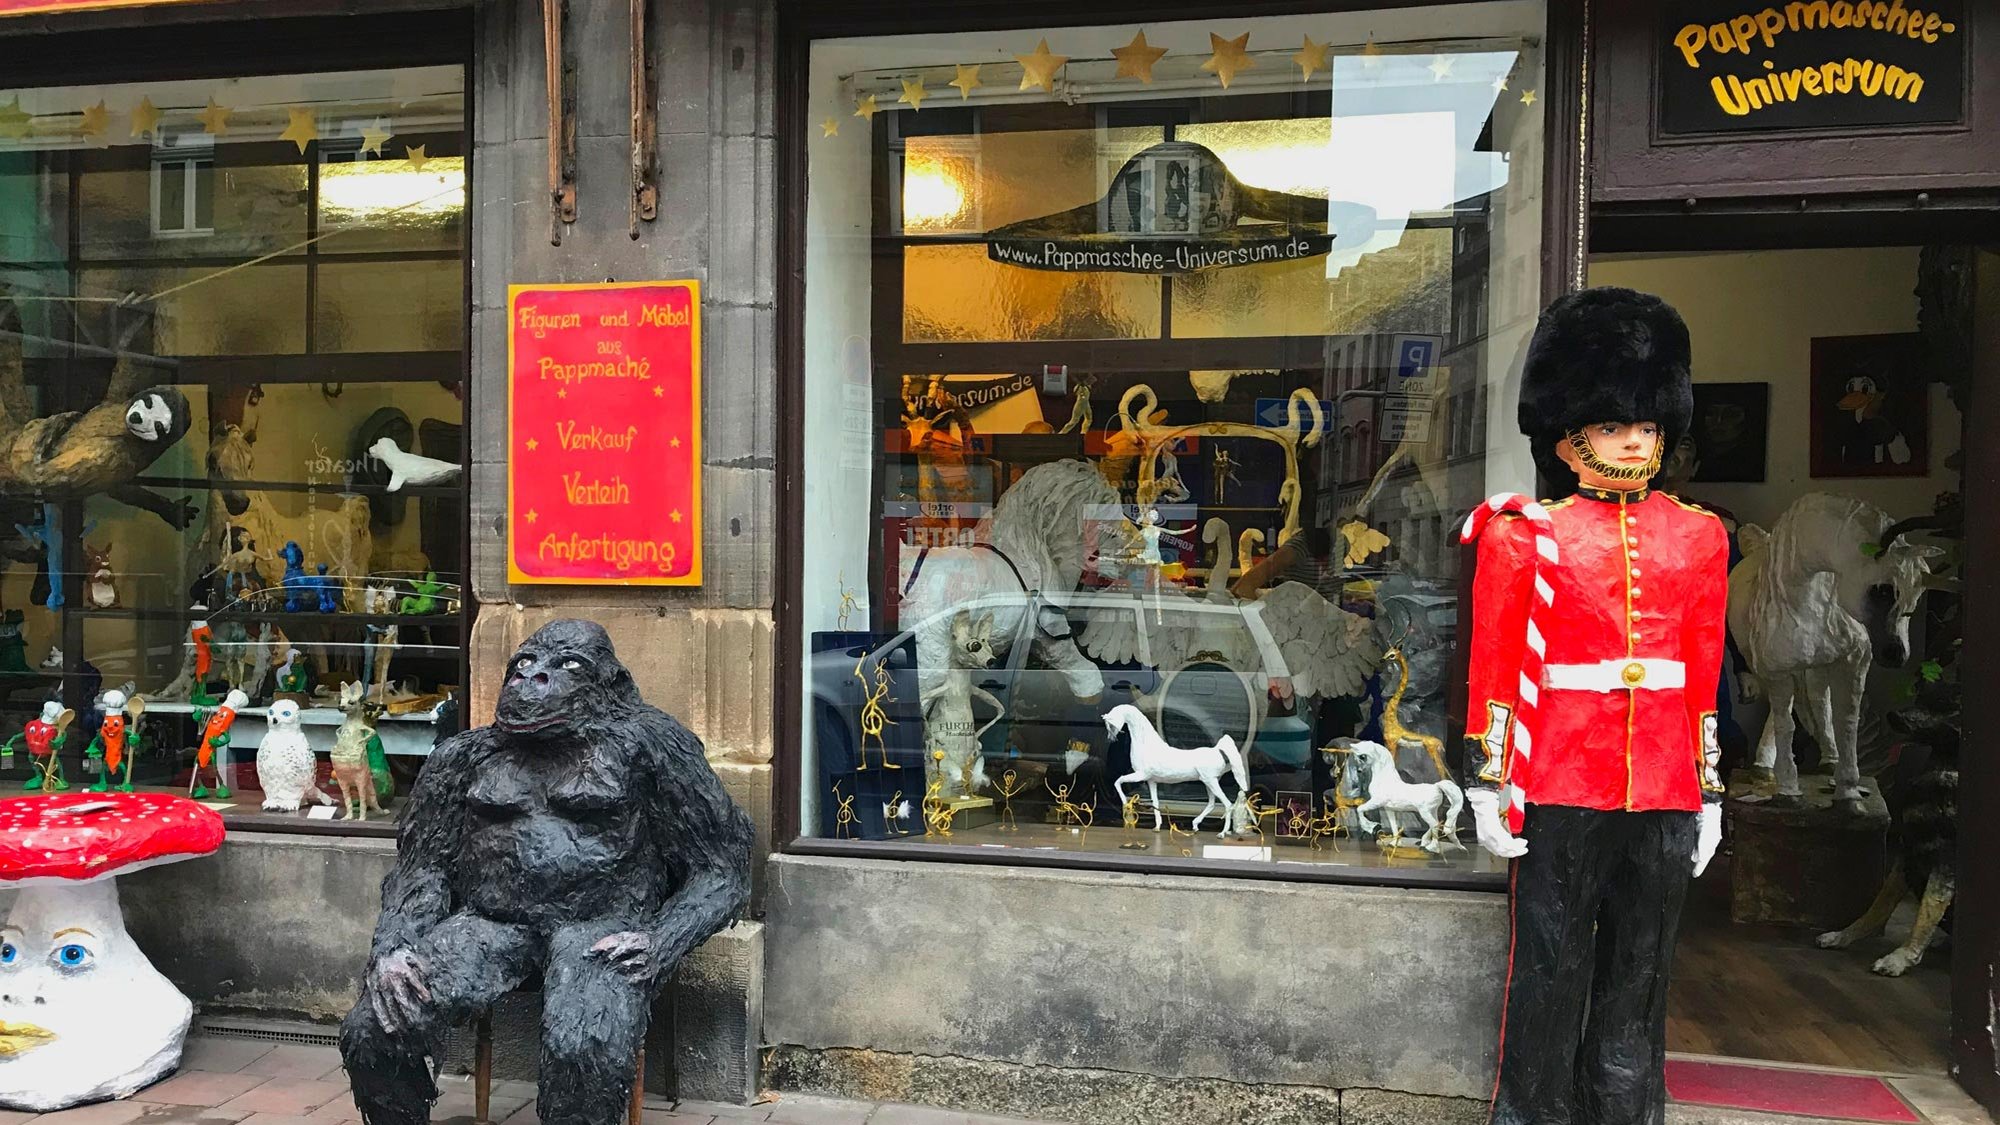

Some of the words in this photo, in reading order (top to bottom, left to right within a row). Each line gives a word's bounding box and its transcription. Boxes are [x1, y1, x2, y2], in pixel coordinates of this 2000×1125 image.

[1673, 0, 1955, 68] Pappmaschee-
[1710, 57, 1924, 115] Universum
[518, 305, 581, 338] Figuren
[600, 310, 630, 327] und
[636, 303, 690, 328] Möbel
[597, 339, 622, 355] aus
[537, 356, 652, 385] Pappmaché
[555, 418, 638, 453] Verkauf
[561, 471, 630, 505] Verleih
[538, 531, 676, 573] Anfertigung
